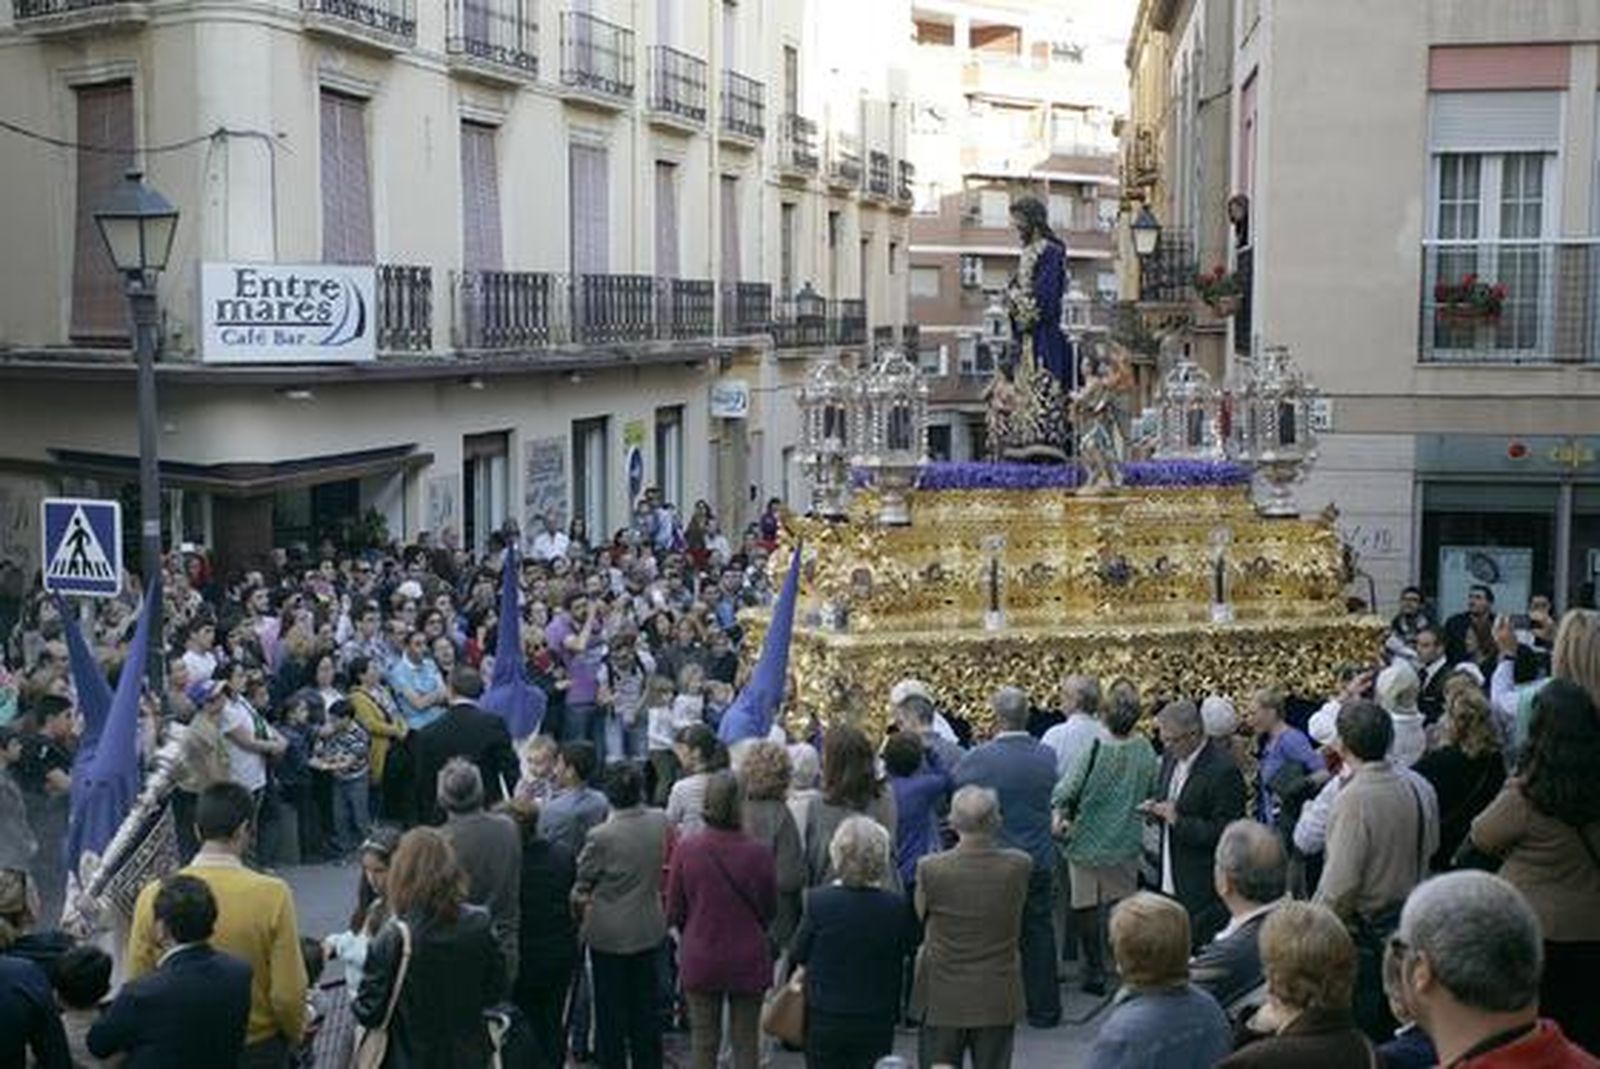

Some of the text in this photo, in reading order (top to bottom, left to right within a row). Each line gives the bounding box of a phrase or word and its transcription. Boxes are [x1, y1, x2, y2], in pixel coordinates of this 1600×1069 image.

[235, 268, 341, 300] Entre
[215, 299, 332, 321] mares
[221, 329, 306, 346] Café Bar
